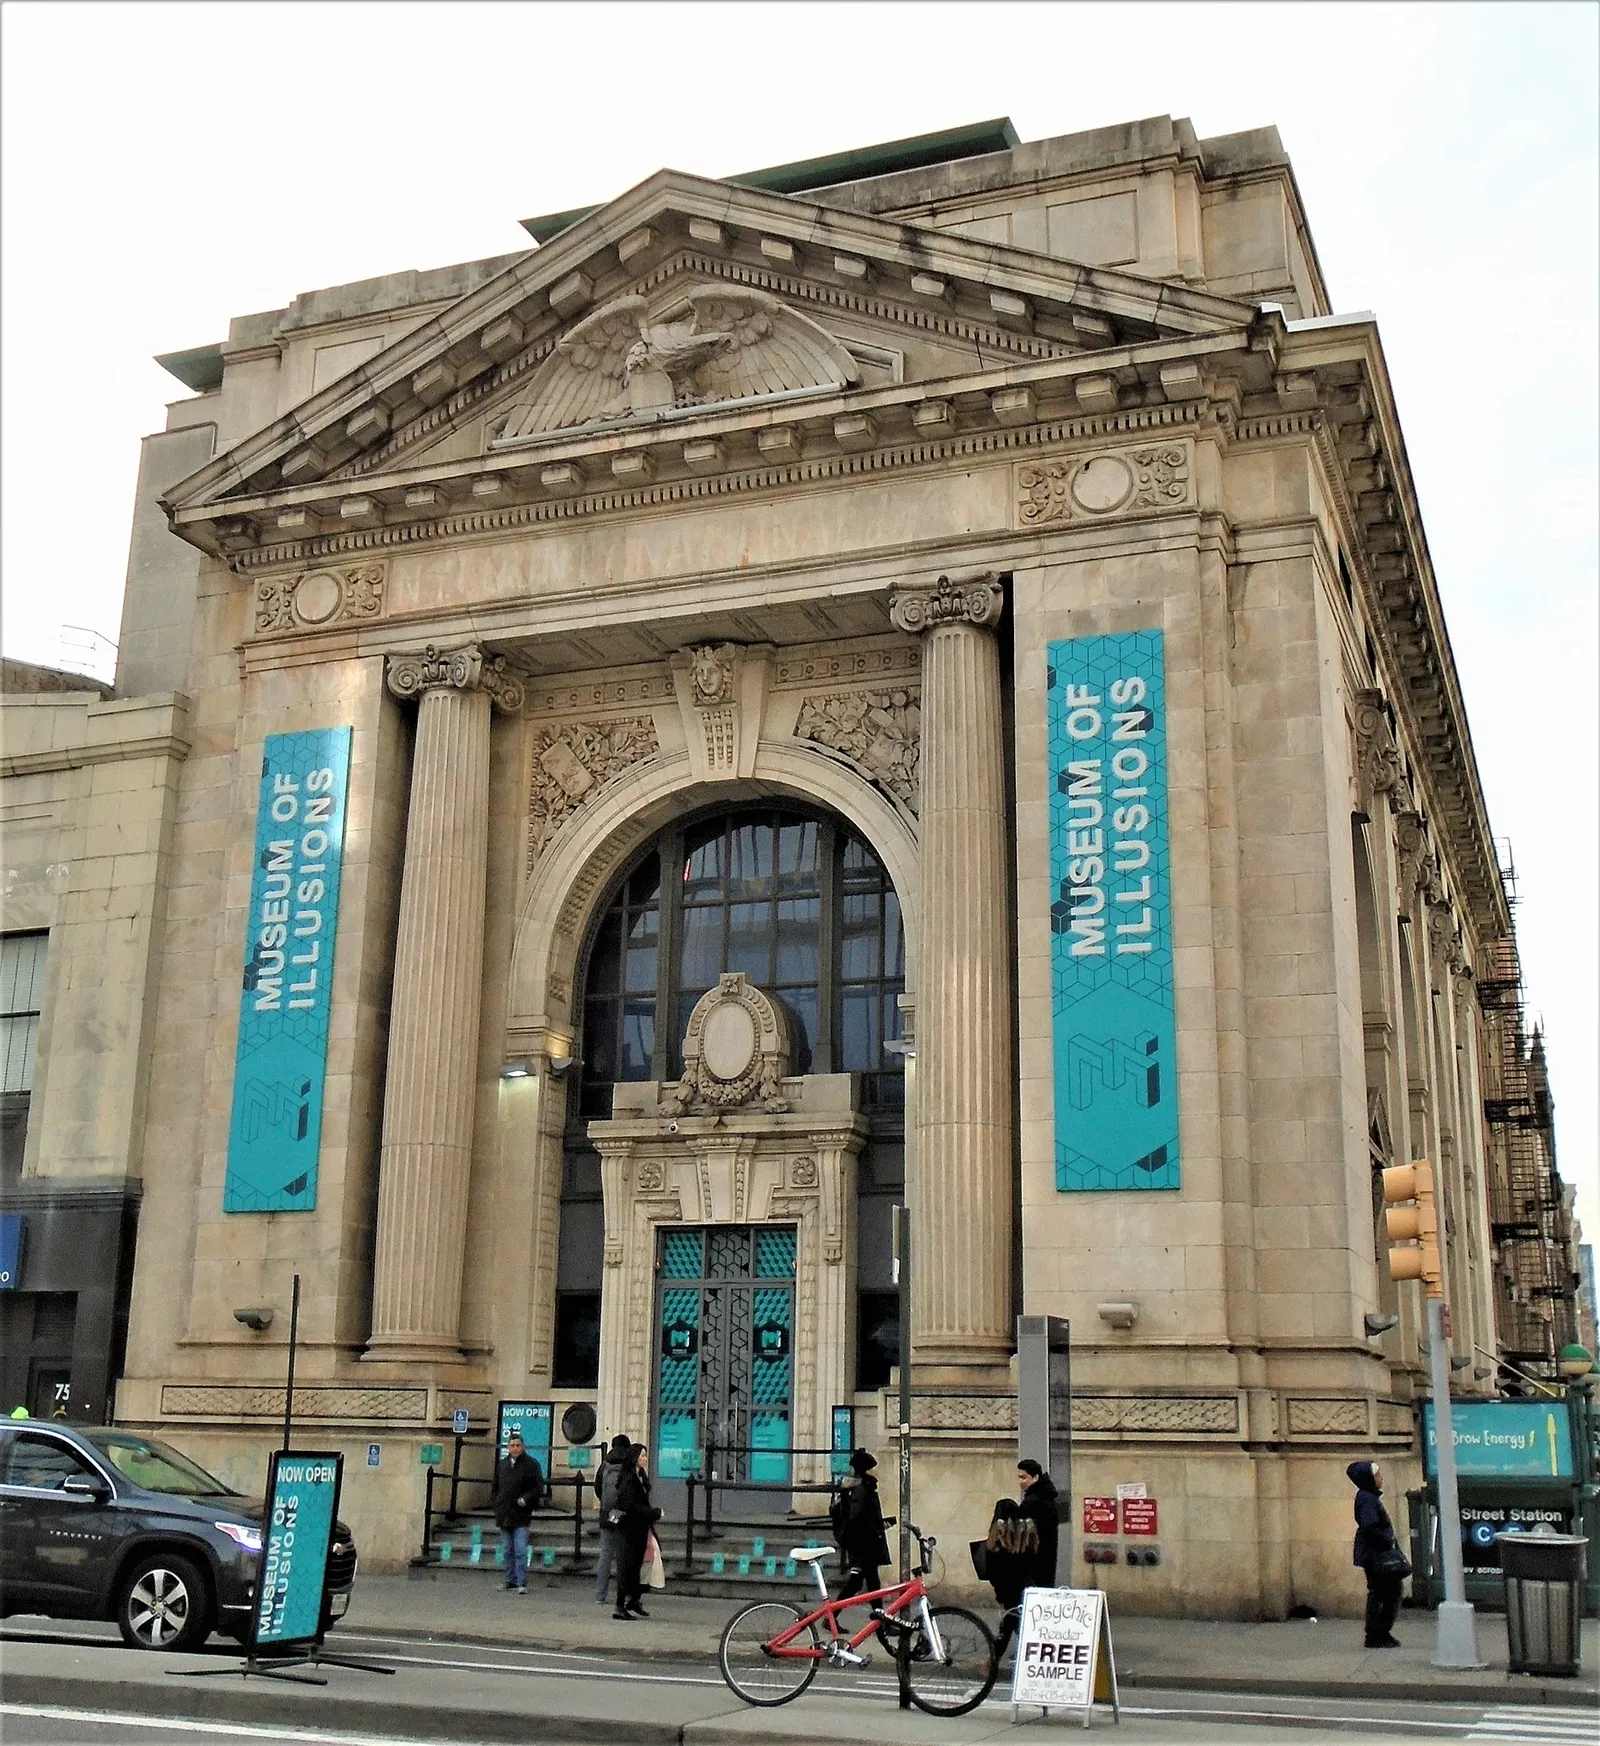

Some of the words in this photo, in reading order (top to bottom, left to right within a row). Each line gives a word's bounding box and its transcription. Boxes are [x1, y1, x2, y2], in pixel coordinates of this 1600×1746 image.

[1066, 684, 1101, 739] OF
[272, 773, 299, 823] OF
[1110, 677, 1152, 952] ILLUSIONS
[1068, 759, 1105, 955] MUSEUM
[288, 768, 334, 1009] ILLUSIONS
[255, 839, 295, 1011] MUSEUM
[55, 1383, 71, 1401] 75
[502, 1408, 525, 1417] NOW
[525, 1408, 550, 1417] OPEN
[502, 1422, 511, 1438] OF
[1484, 1429, 1526, 1448] Energy
[277, 1466, 304, 1482] NOW
[305, 1466, 336, 1483] OPEN
[1461, 1508, 1505, 1520] Street
[1510, 1509, 1563, 1522] Station
[1477, 1526, 1491, 1541] C
[258, 1536, 282, 1636] MUSEUM
[273, 1495, 287, 1526] OF
[271, 1494, 299, 1635] ILLUSIONS
[1029, 1600, 1093, 1631] Psychic
[1039, 1626, 1084, 1641] Reader
[1024, 1642, 1090, 1665] FREE
[1027, 1665, 1084, 1681] SAMPLE
